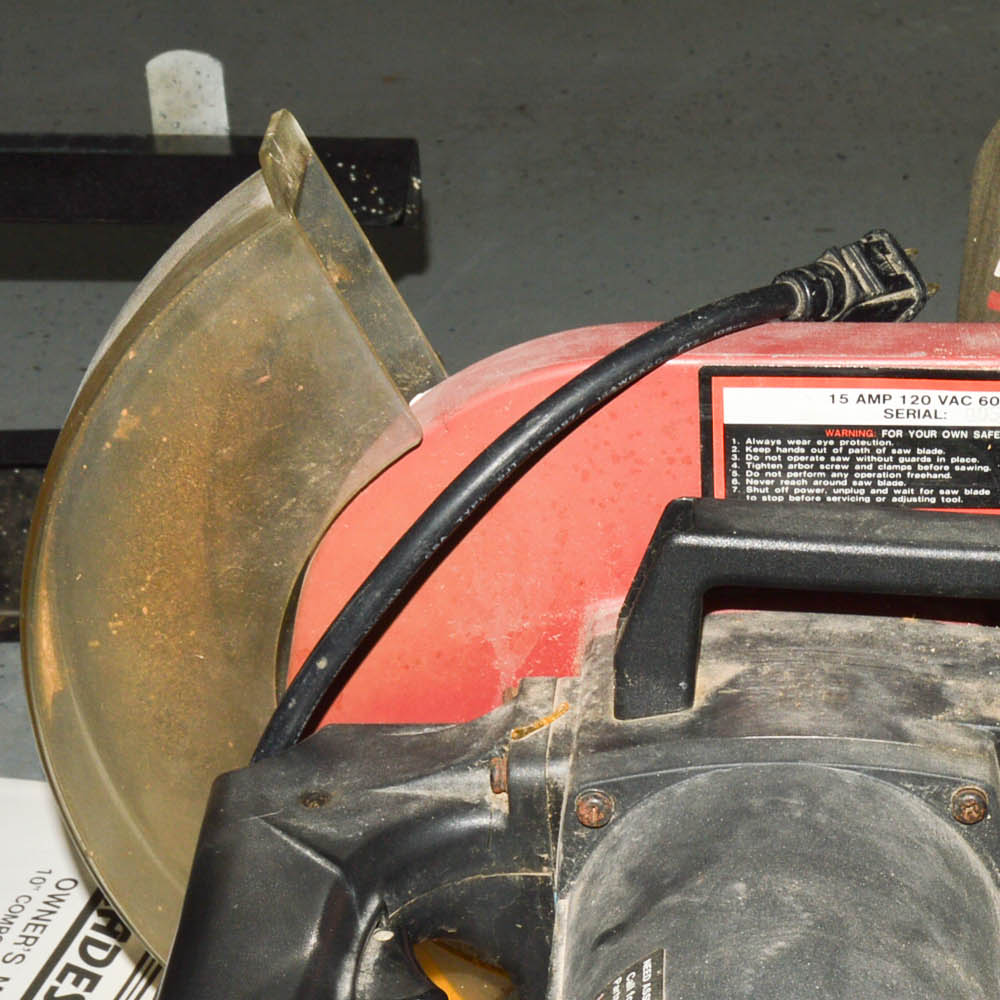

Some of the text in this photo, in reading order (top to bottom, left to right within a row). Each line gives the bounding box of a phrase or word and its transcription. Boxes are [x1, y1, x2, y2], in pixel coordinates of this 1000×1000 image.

[829, 394, 849, 404] 15
[856, 394, 892, 404] AMP
[902, 395, 931, 405] 120
[938, 395, 972, 406] VAC
[883, 409, 947, 419] SERIAL:
[825, 429, 876, 437] WARNING:
[882, 430, 903, 438] FOR
[908, 430, 937, 438] YOUR
[942, 430, 968, 438] OWN
[746, 438, 782, 447] Always
[746, 446, 771, 455] Keep
[848, 447, 870, 455] path
[787, 455, 825, 463] operate
[899, 456, 932, 464] guards
[951, 456, 979, 465] place.
[746, 462, 783, 471] Tighten
[878, 463, 912, 472] clamps
[955, 464, 991, 473] sawing.
[787, 471, 825, 479] perform
[854, 471, 901, 480] operation
[833, 487, 865, 496] unplug
[762, 495, 784, 503] stop
[892, 496, 936, 504] adjusting
[0, 894, 32, 943] COMP
[2, 878, 78, 965] OWNER'S
[642, 958, 652, 982] NEED
[626, 971, 636, 992] Call
